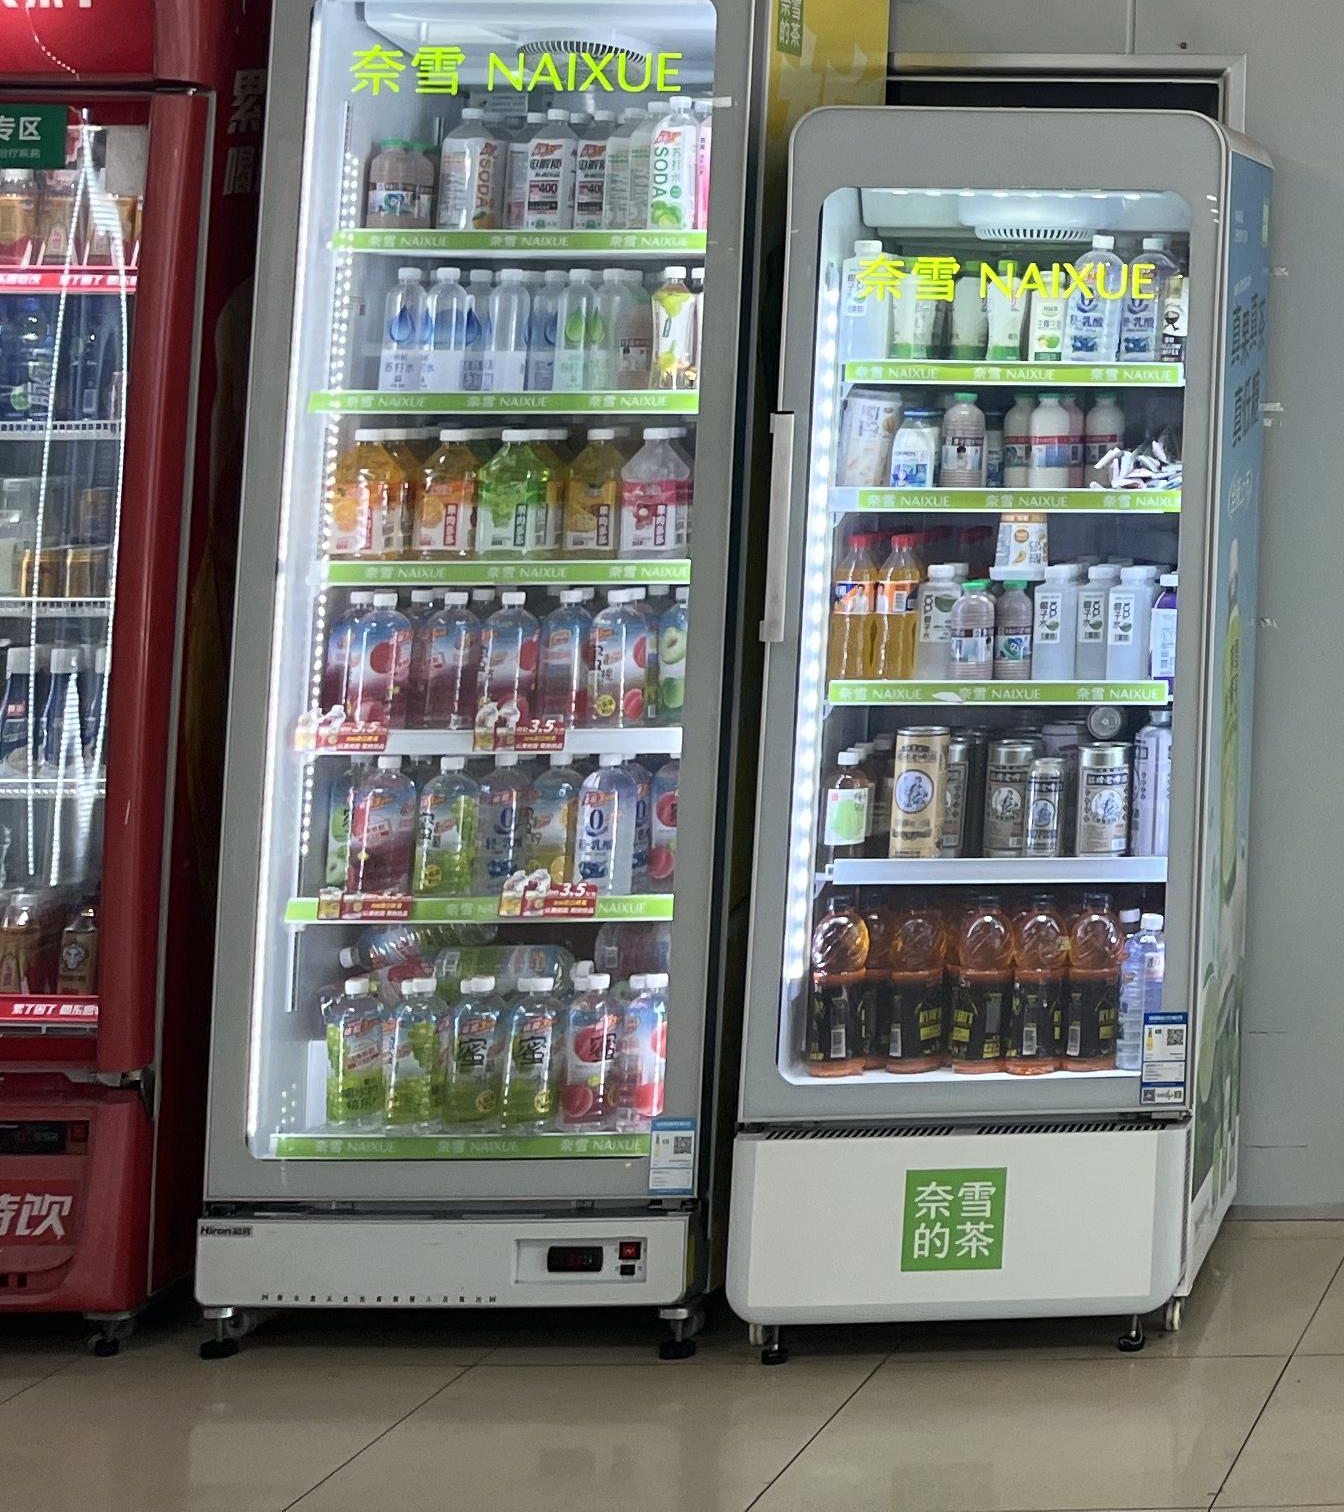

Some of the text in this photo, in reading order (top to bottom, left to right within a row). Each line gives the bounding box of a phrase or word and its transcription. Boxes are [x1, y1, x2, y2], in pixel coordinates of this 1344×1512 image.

[349, 45, 682, 96] 奈雪 NAIXUE
[651, 147, 669, 199] SODA
[857, 254, 1156, 302] 奈雪 NAIXUE
[888, 367, 939, 381] NAIXUE
[1006, 367, 1056, 381] NAIXUE
[1122, 367, 1172, 381] NAIXUE
[901, 495, 950, 507] NAIXUE
[1018, 495, 1068, 507] NAIXUE
[872, 688, 923, 700] NAIXUE
[991, 688, 1041, 700] NAIXUE
[1109, 688, 1159, 700] NAIXUE
[529, 719, 556, 732] 3.5
[561, 883, 587, 897] 3.5
[914, 1180, 998, 1220] 奈雪
[912, 1221, 996, 1260] 的茶
